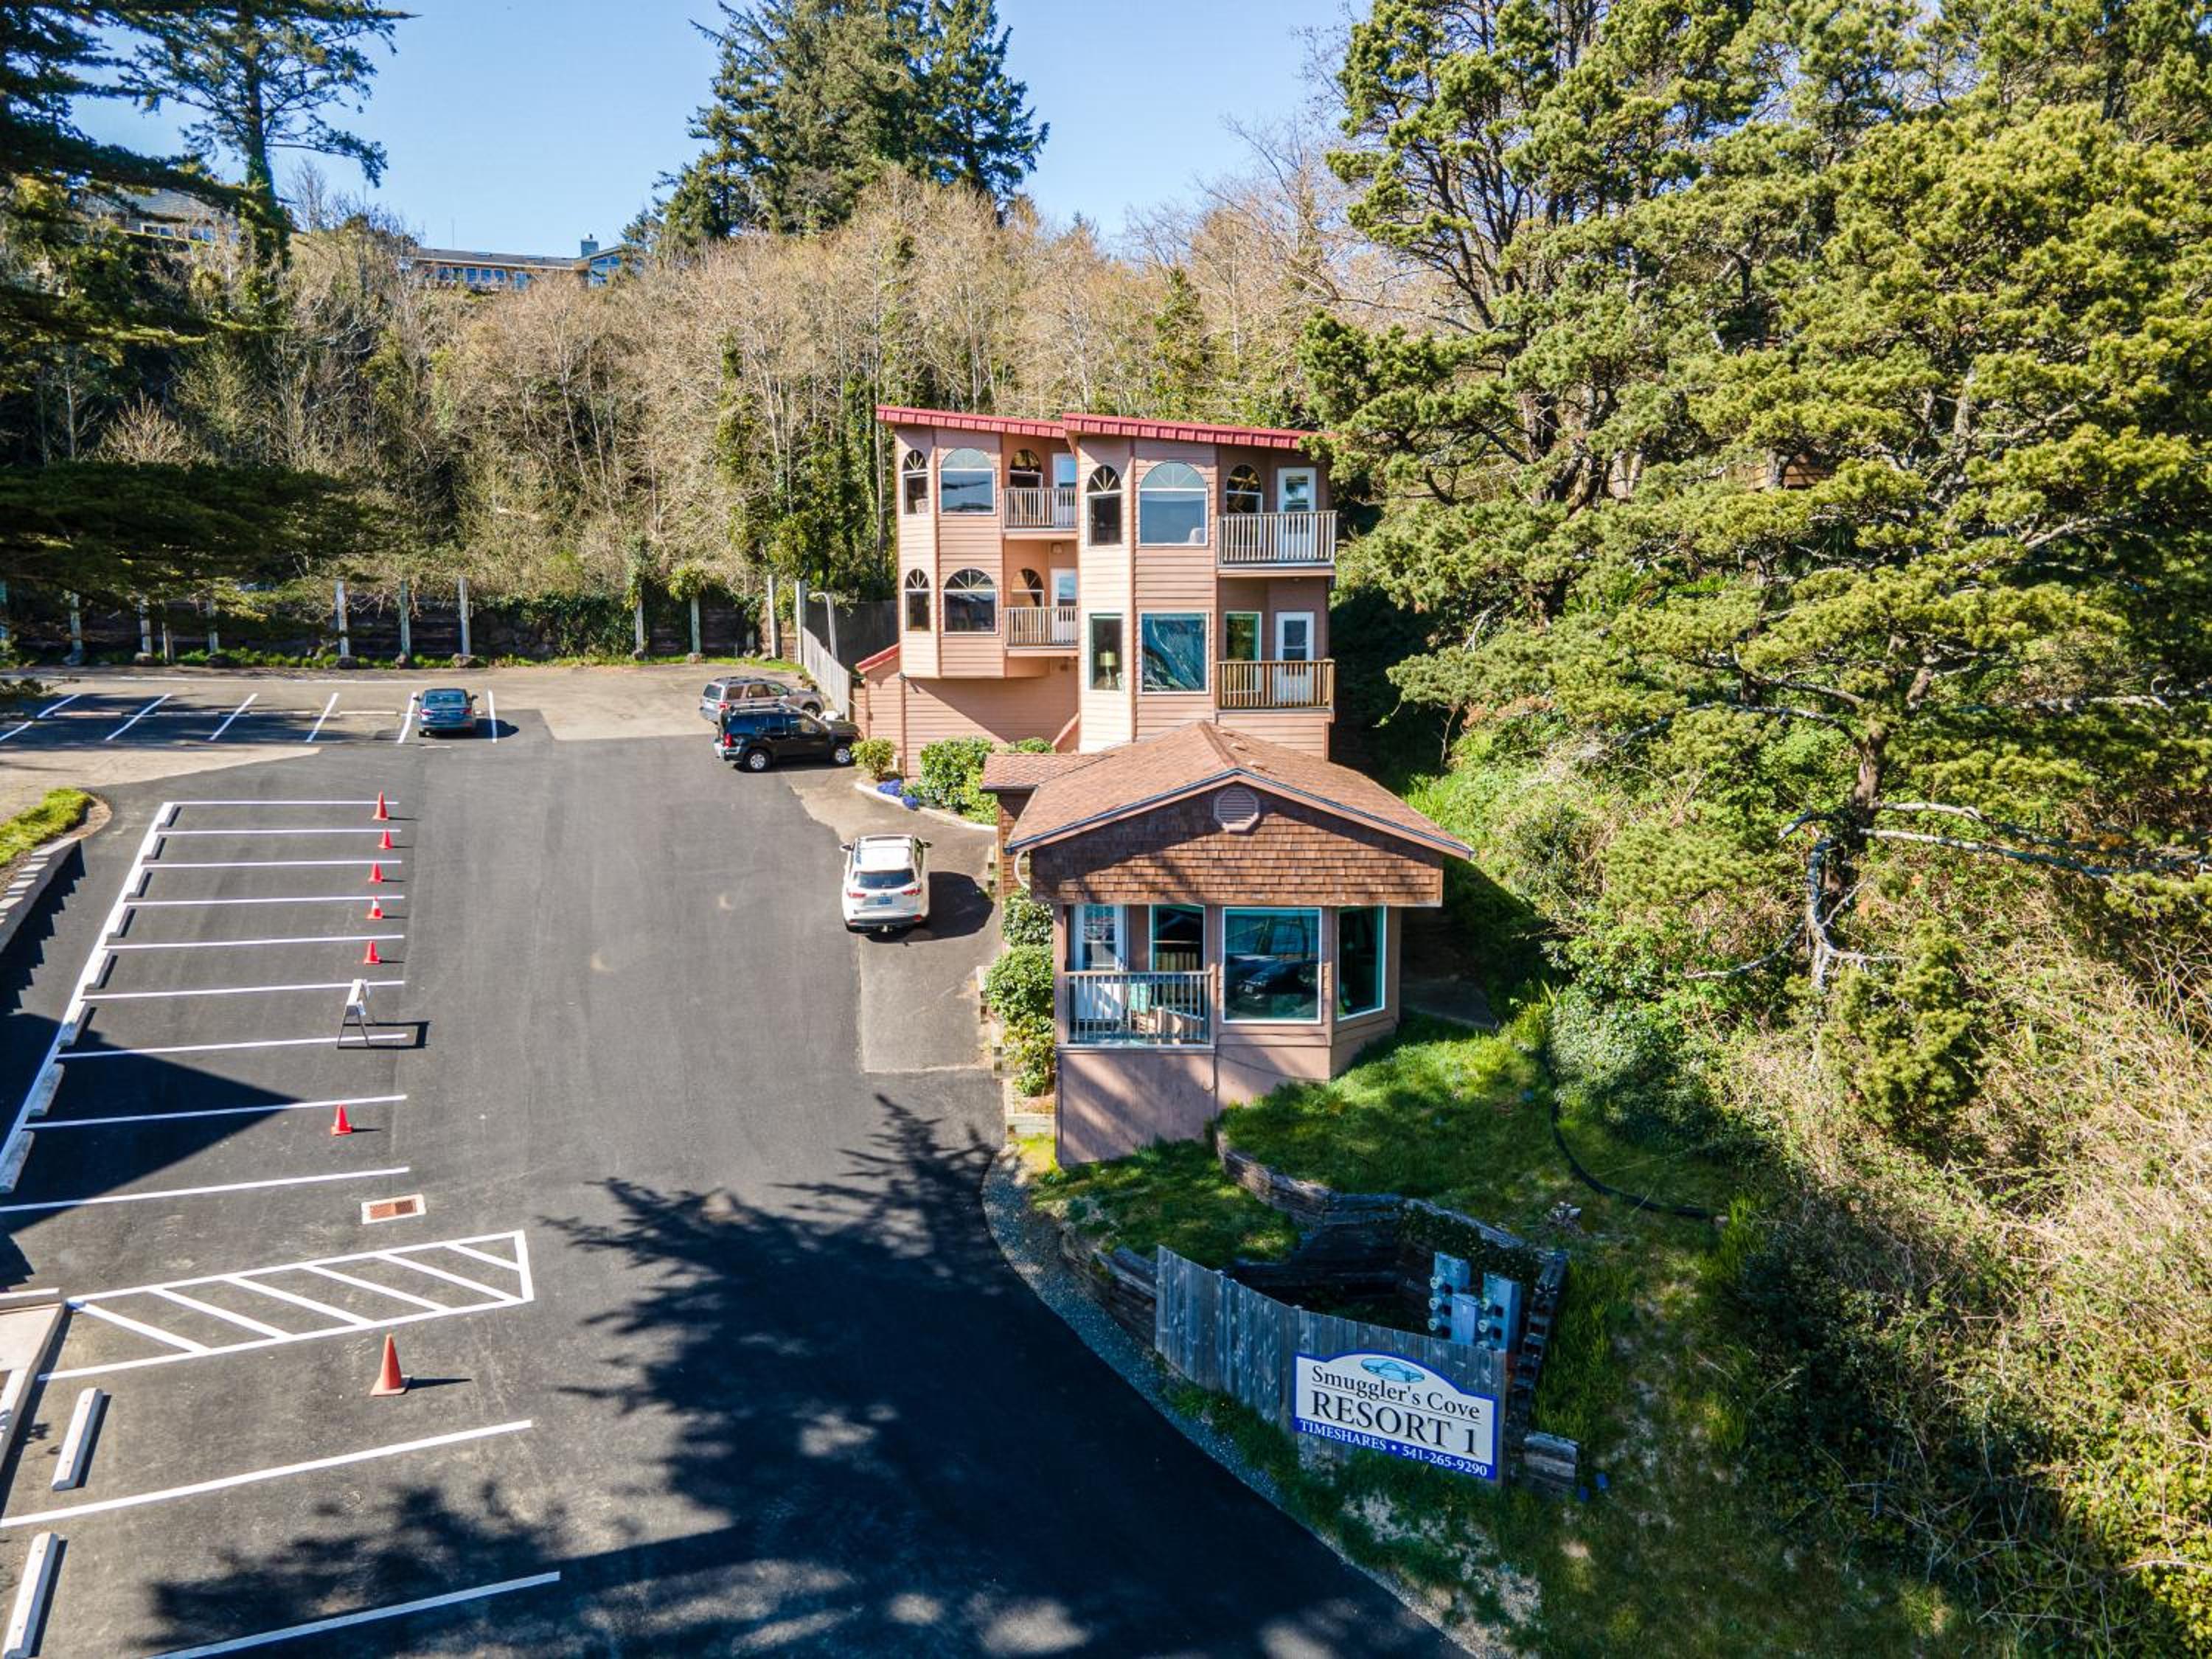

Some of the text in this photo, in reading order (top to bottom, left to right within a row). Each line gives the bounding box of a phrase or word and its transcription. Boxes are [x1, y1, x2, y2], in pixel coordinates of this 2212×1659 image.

[1310, 1390, 1452, 1449] RESORT
[1312, 1365, 1481, 1419] Smuggler's Cove
[1300, 1419, 1487, 1477] TIMESHARES 541-265-9290
